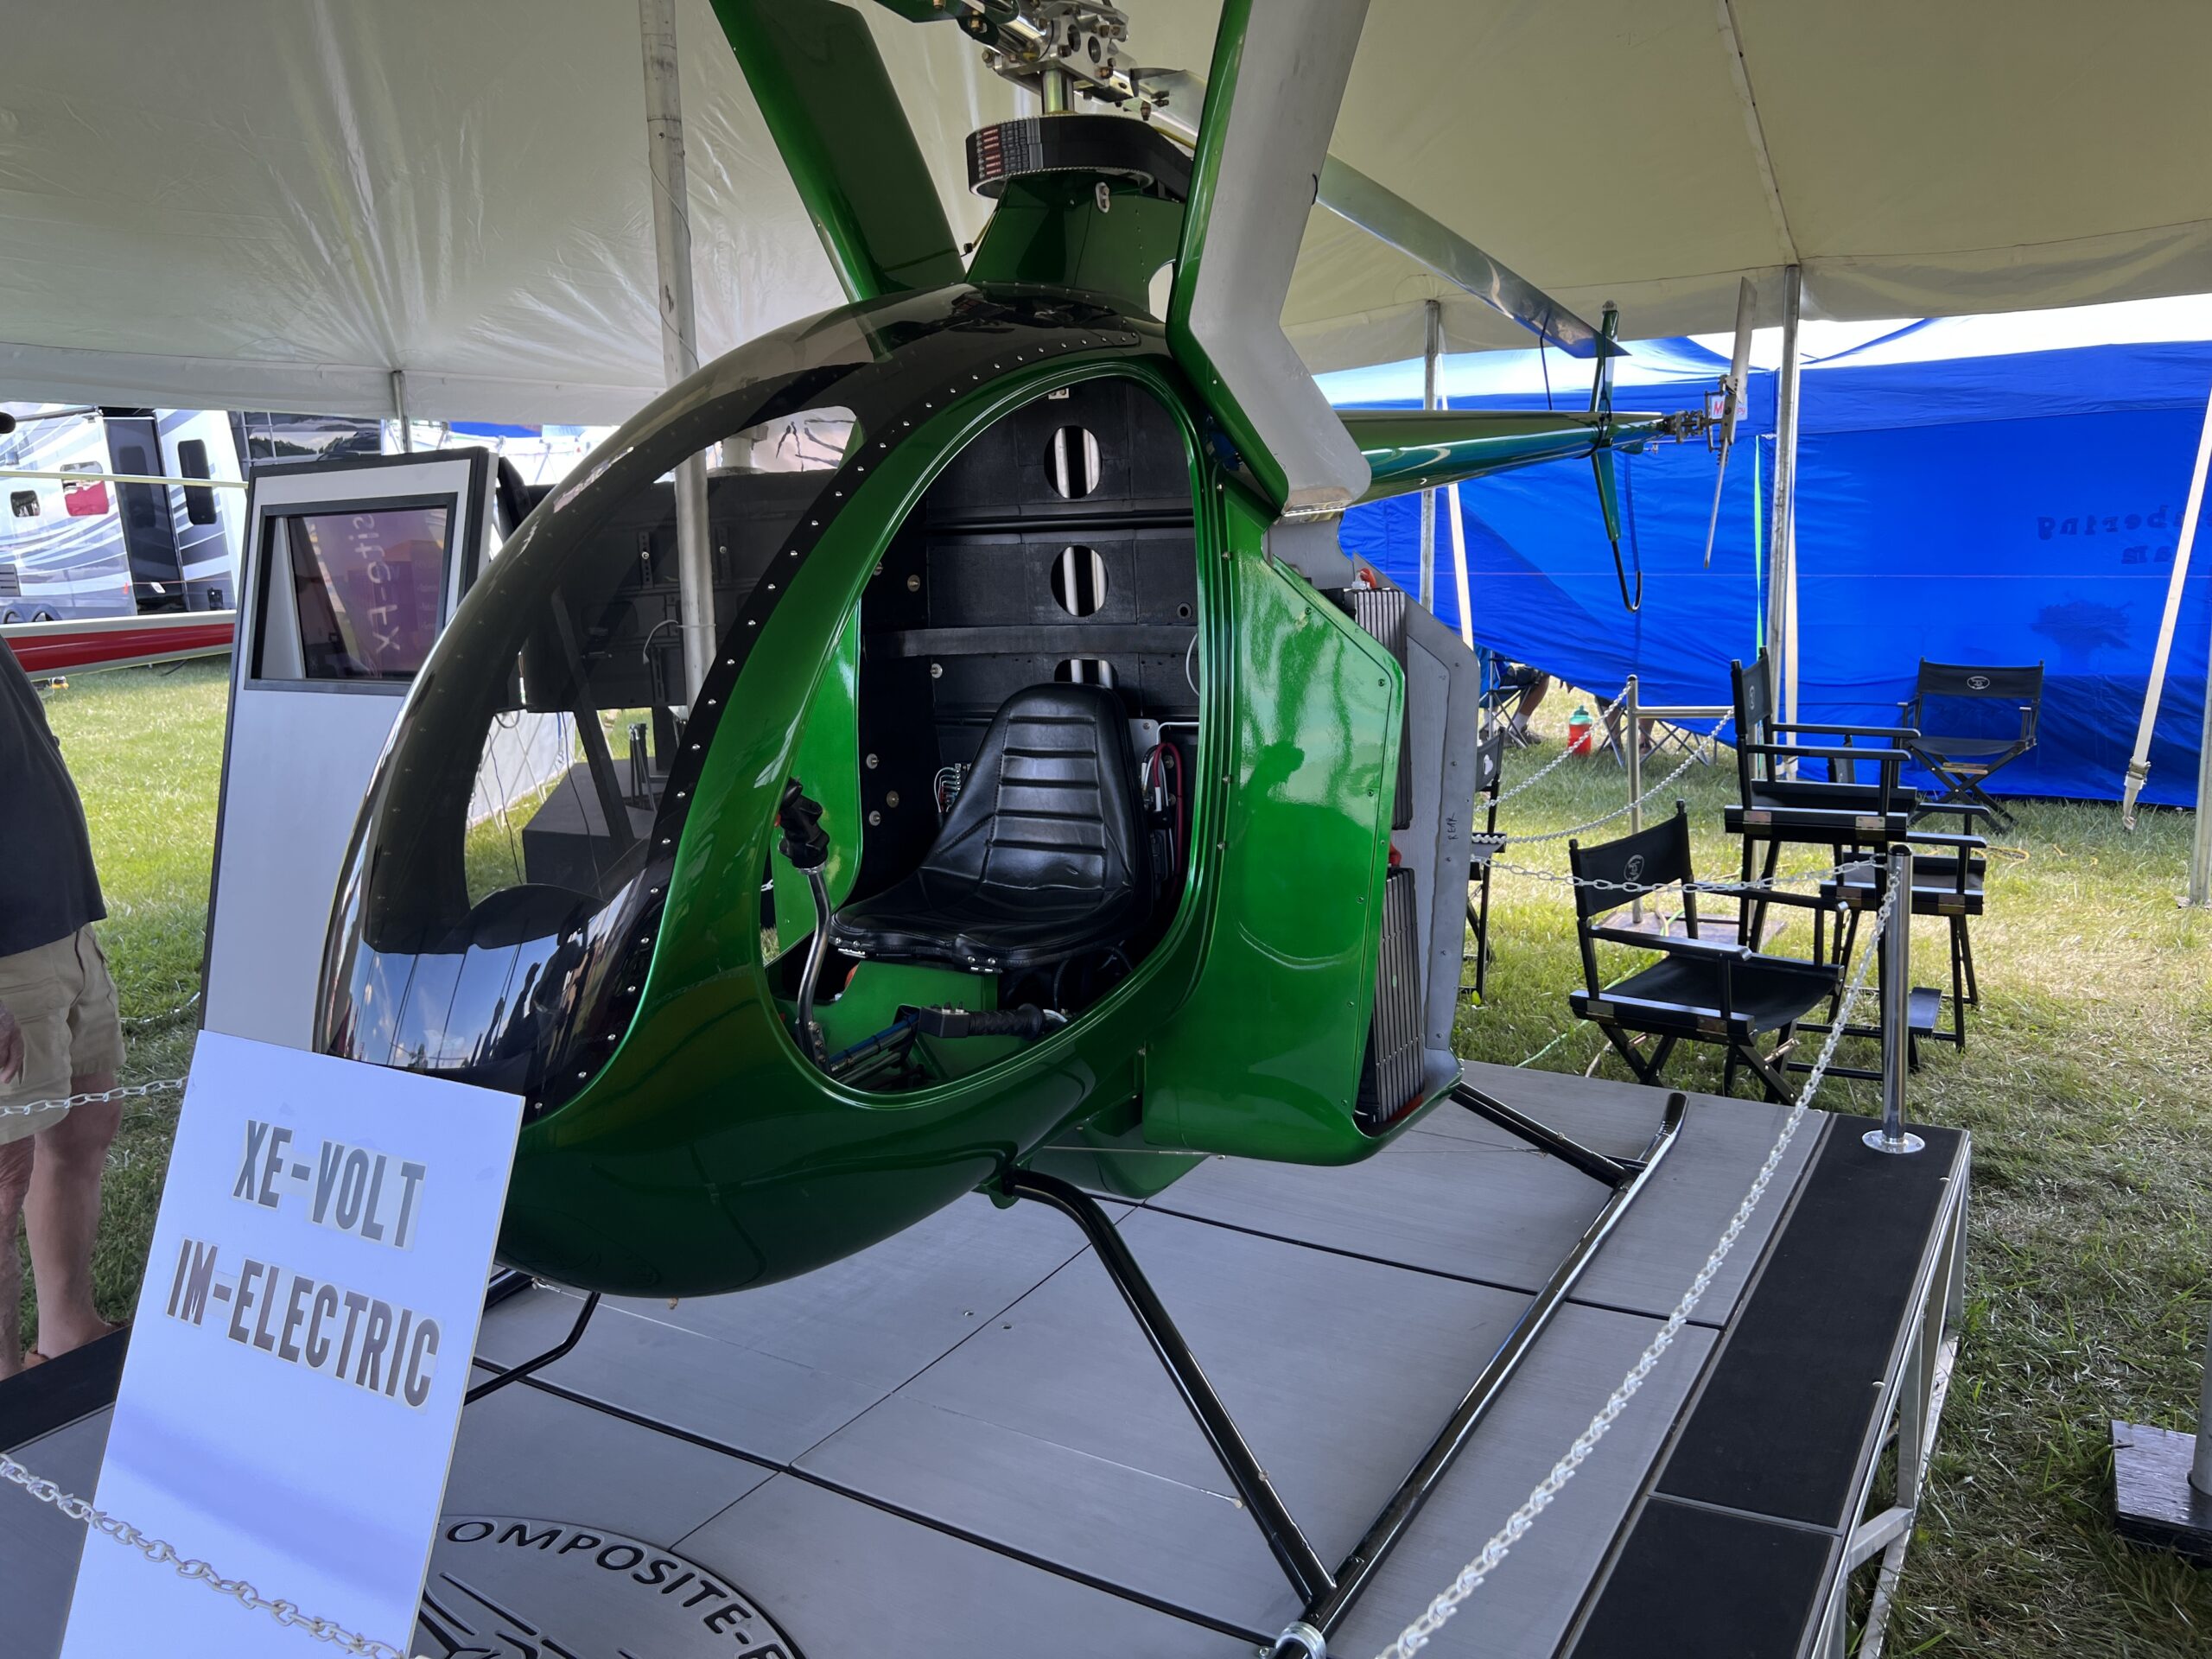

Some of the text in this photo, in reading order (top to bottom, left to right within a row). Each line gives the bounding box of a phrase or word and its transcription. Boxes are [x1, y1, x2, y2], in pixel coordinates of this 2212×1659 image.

[232, 1119, 426, 1248] XE-VOLT
[167, 1238, 440, 1407] IM-ELECTRIC
[438, 1521, 788, 1659] OMPOSITE-
